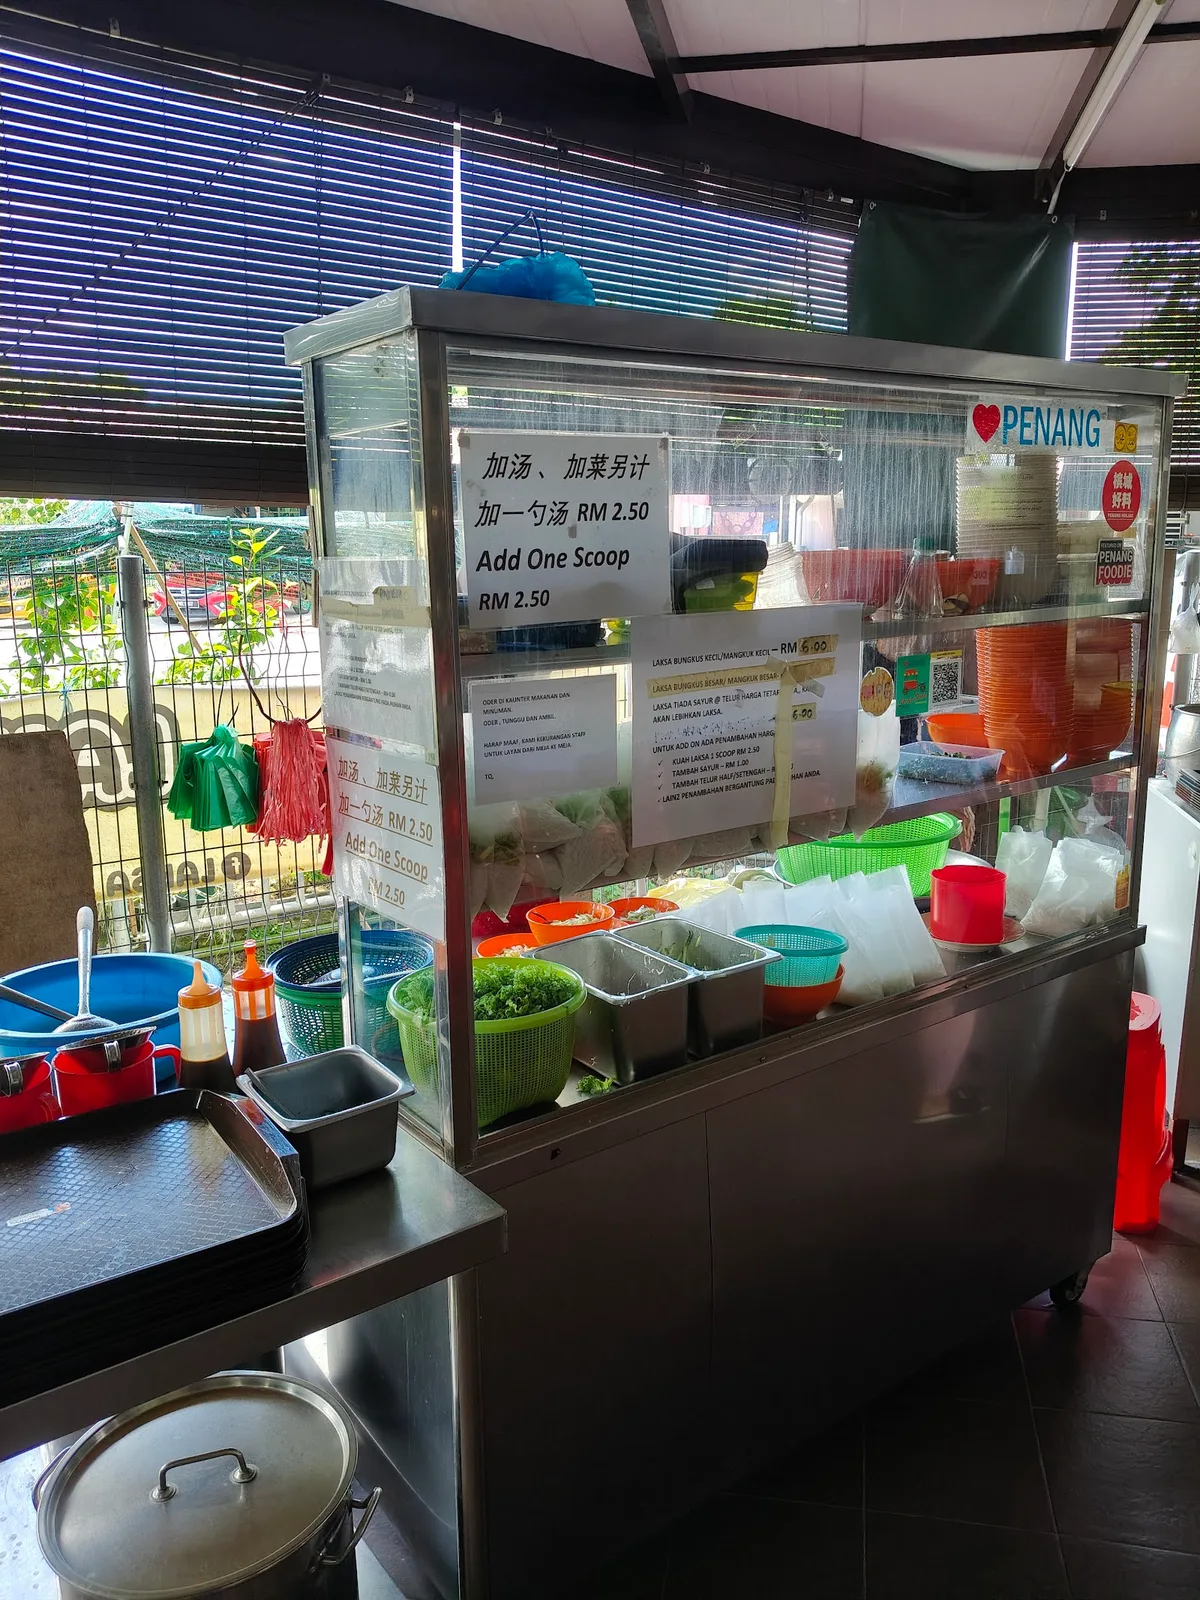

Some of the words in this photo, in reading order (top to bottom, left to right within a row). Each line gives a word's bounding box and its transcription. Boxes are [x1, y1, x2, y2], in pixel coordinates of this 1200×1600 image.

[1002, 405, 1101, 447] PENANG
[474, 500, 569, 528] 加一勺汤
[577, 502, 607, 522] RM
[612, 501, 649, 521] 2.50
[476, 548, 521, 572] Add
[527, 548, 568, 569] One
[573, 546, 630, 570] Scoop
[1099, 550, 1133, 563] PENANG
[1098, 564, 1132, 579] FOODIE
[479, 592, 509, 610] RM
[514, 589, 550, 608] 2.50
[652, 659, 672, 667] LAKSA
[674, 656, 703, 665] BUNGKUS
[704, 650, 755, 662] KECIL/MANGKUK
[755, 649, 770, 657] KECIL
[780, 641, 797, 654] RM
[652, 685, 673, 693] LAKSA
[674, 682, 703, 691] BUNGKUS
[727, 676, 758, 685] MANGKUK
[531, 693, 558, 701] MAKANAN
[652, 703, 673, 711] LAKSA
[673, 701, 692, 709] TIADA
[693, 697, 714, 706] SAYUR
[722, 694, 741, 702] TELUR
[740, 691, 762, 700] HARGA
[672, 712, 701, 721] LEBIHKAN
[483, 741, 502, 749] HARAP
[536, 733, 571, 743] KEKURANGAN
[652, 745, 674, 754] UNTUK
[675, 742, 689, 750] ADD
[700, 739, 714, 747] ADA
[715, 732, 757, 744] PENAMBAHAN
[758, 729, 775, 738] HARG
[484, 750, 504, 758] UNTUK
[504, 748, 521, 756] LAYAN
[672, 756, 690, 766] KUAH
[691, 754, 709, 762] LAKSA
[711, 752, 714, 760] 1
[715, 750, 735, 758] SCOOP
[672, 767, 699, 778] TAMBAH
[699, 764, 719, 773] SAYUR
[736, 759, 749, 767] 1.00
[672, 779, 699, 790] TAMBAH
[699, 776, 718, 784] TELUR
[718, 768, 766, 782] HALF/SETENGAH
[662, 794, 680, 803] LAIN2
[681, 785, 724, 799] PENAMBAHAN
[724, 780, 765, 792] BERGANTUNG
[765, 777, 776, 785] PAD
[339, 792, 384, 826] 加一勺汤
[388, 811, 406, 832] RM
[409, 819, 433, 841] 2.50
[345, 832, 366, 854] Add
[369, 841, 390, 864] One
[393, 850, 428, 881] Scoop
[385, 884, 405, 905] 2.50
